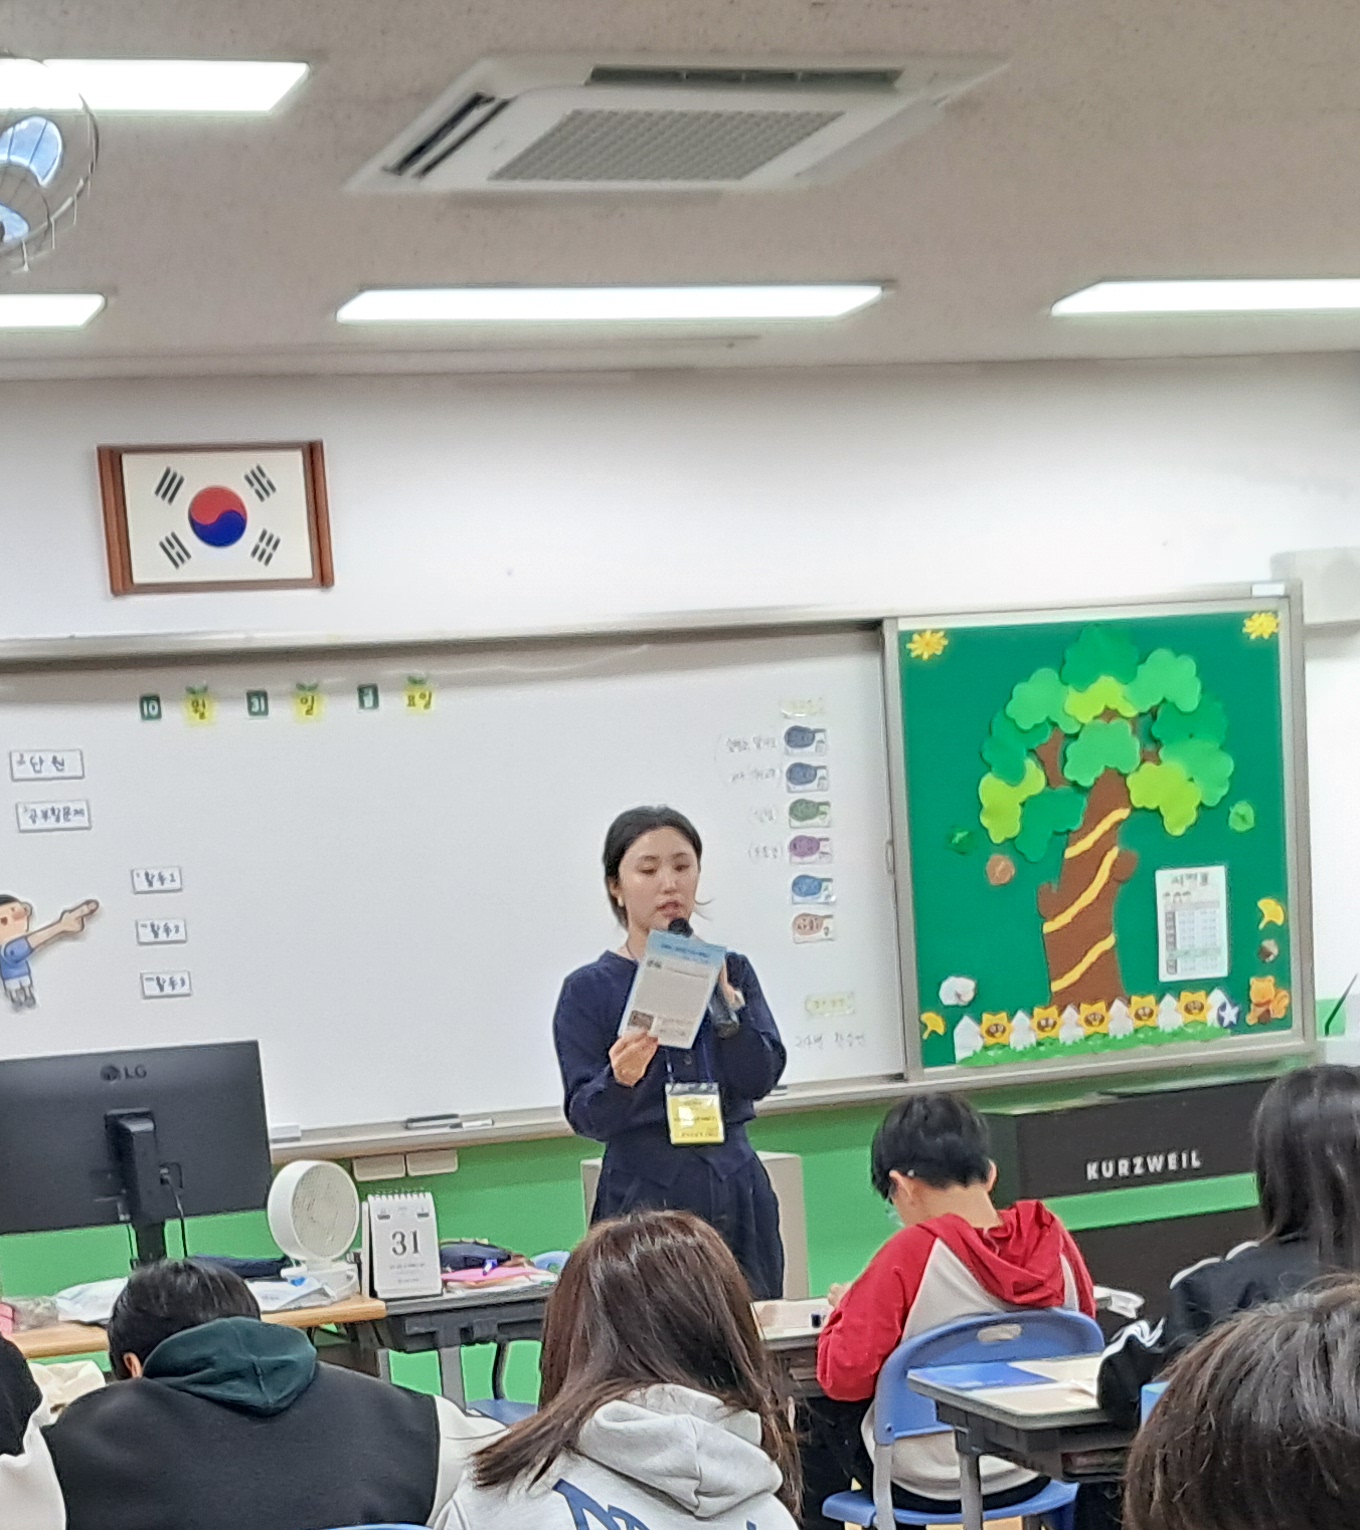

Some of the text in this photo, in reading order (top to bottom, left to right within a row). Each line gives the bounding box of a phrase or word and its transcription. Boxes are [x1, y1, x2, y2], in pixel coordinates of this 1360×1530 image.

[142, 701, 159, 717] 10
[251, 697, 265, 713] 31
[299, 694, 315, 716] 일
[1085, 1149, 1202, 1181] KURZWEIL
[391, 1229, 420, 1256] 31
